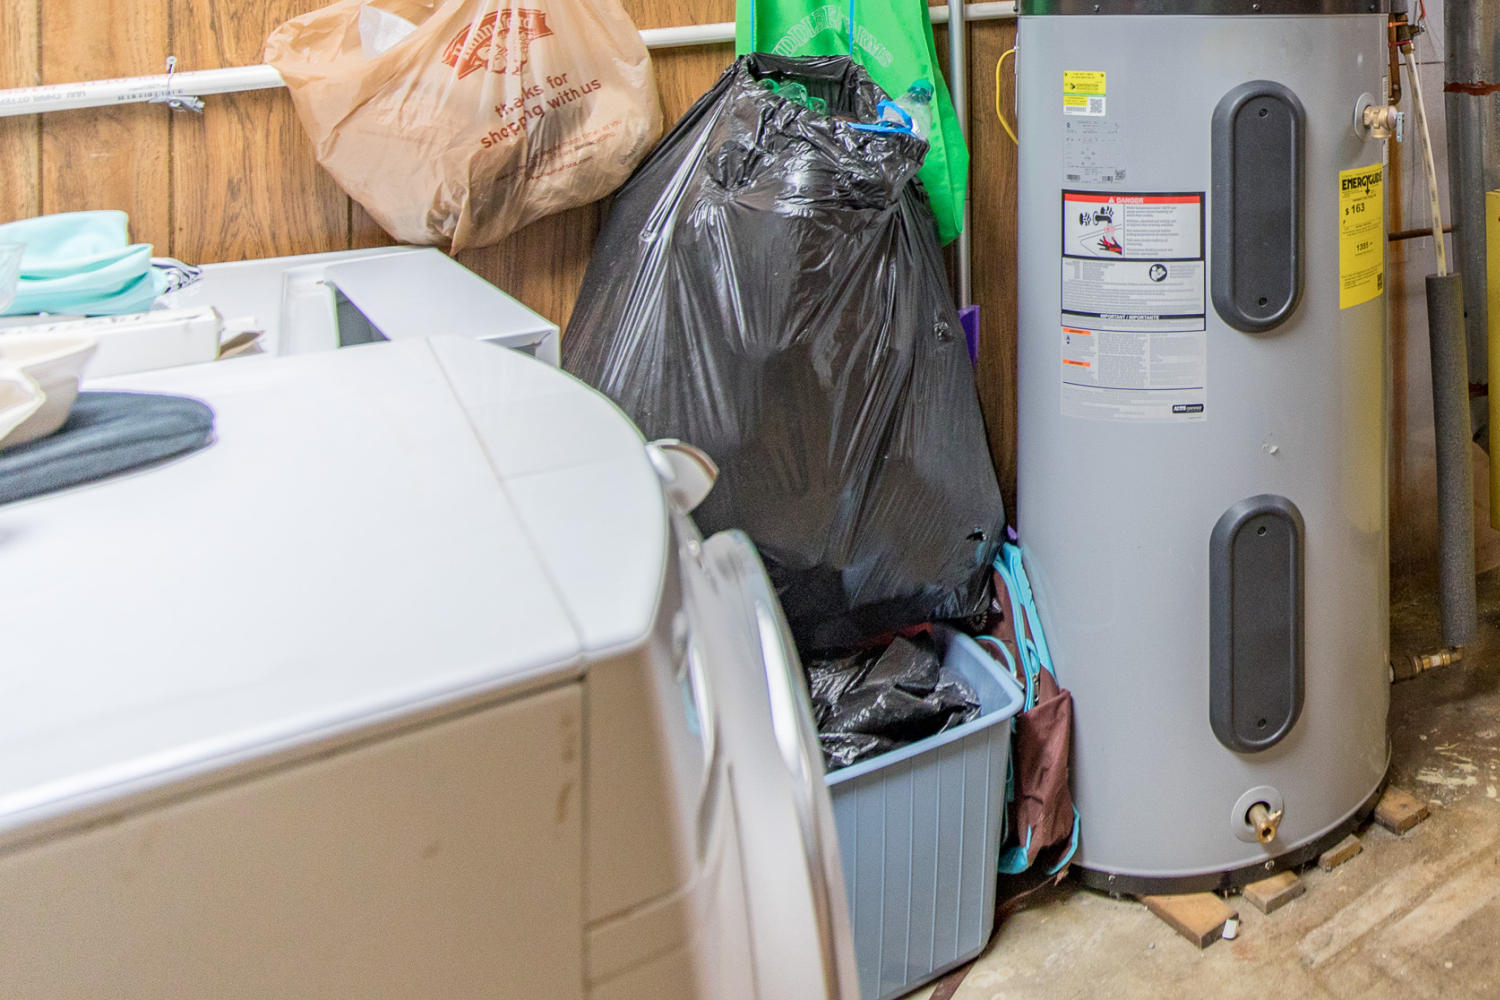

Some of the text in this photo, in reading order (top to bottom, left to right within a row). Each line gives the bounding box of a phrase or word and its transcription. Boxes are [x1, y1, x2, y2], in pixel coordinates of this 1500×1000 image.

[546, 72, 569, 89] for
[547, 88, 581, 109] with
[580, 79, 602, 95] us
